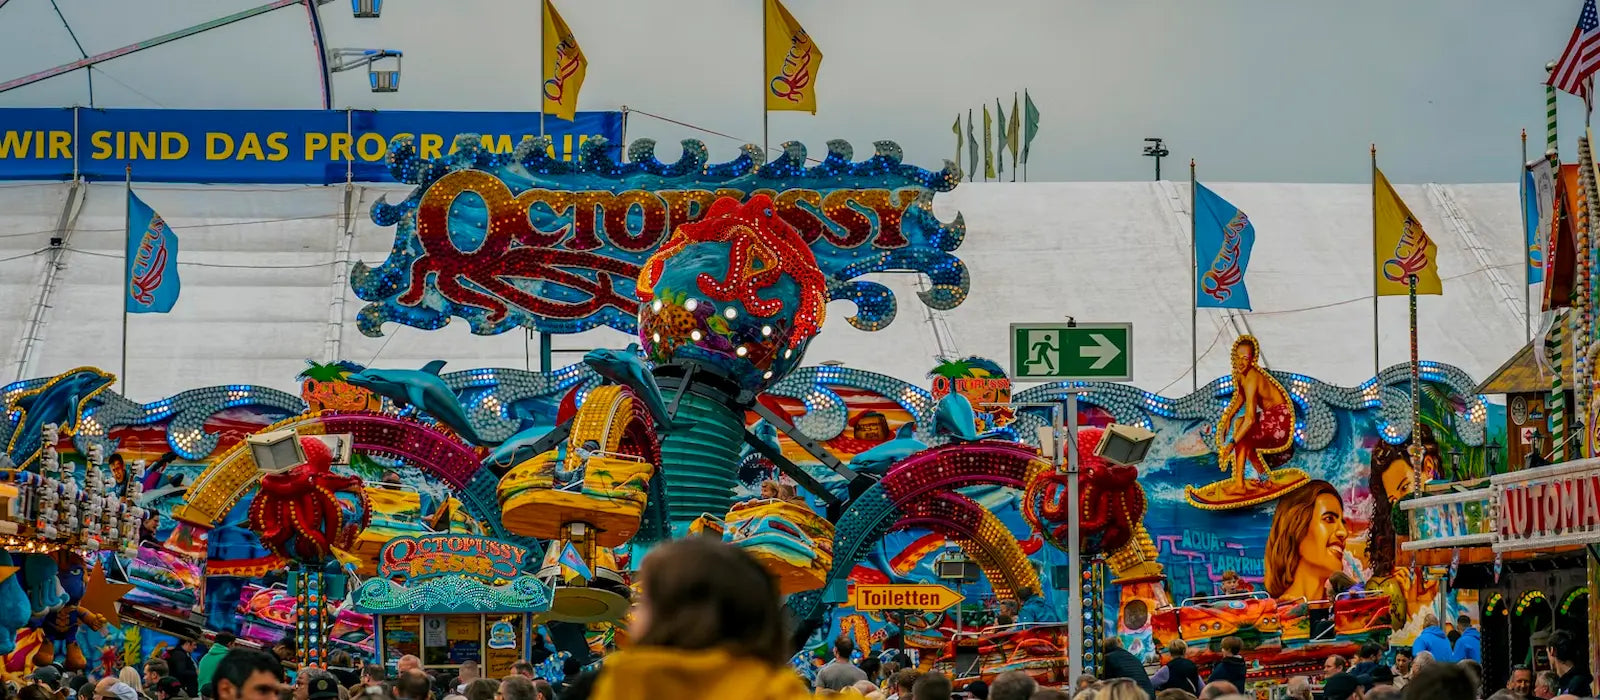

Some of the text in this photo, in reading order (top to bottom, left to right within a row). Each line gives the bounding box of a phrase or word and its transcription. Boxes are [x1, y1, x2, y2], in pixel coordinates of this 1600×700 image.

[0, 131, 73, 159] WIR
[91, 131, 189, 160] SIND
[205, 132, 289, 161] DAS
[382, 537, 526, 567] OCTOPUSSY
[410, 554, 494, 578] KASSE
[862, 590, 940, 606] Toiletten
